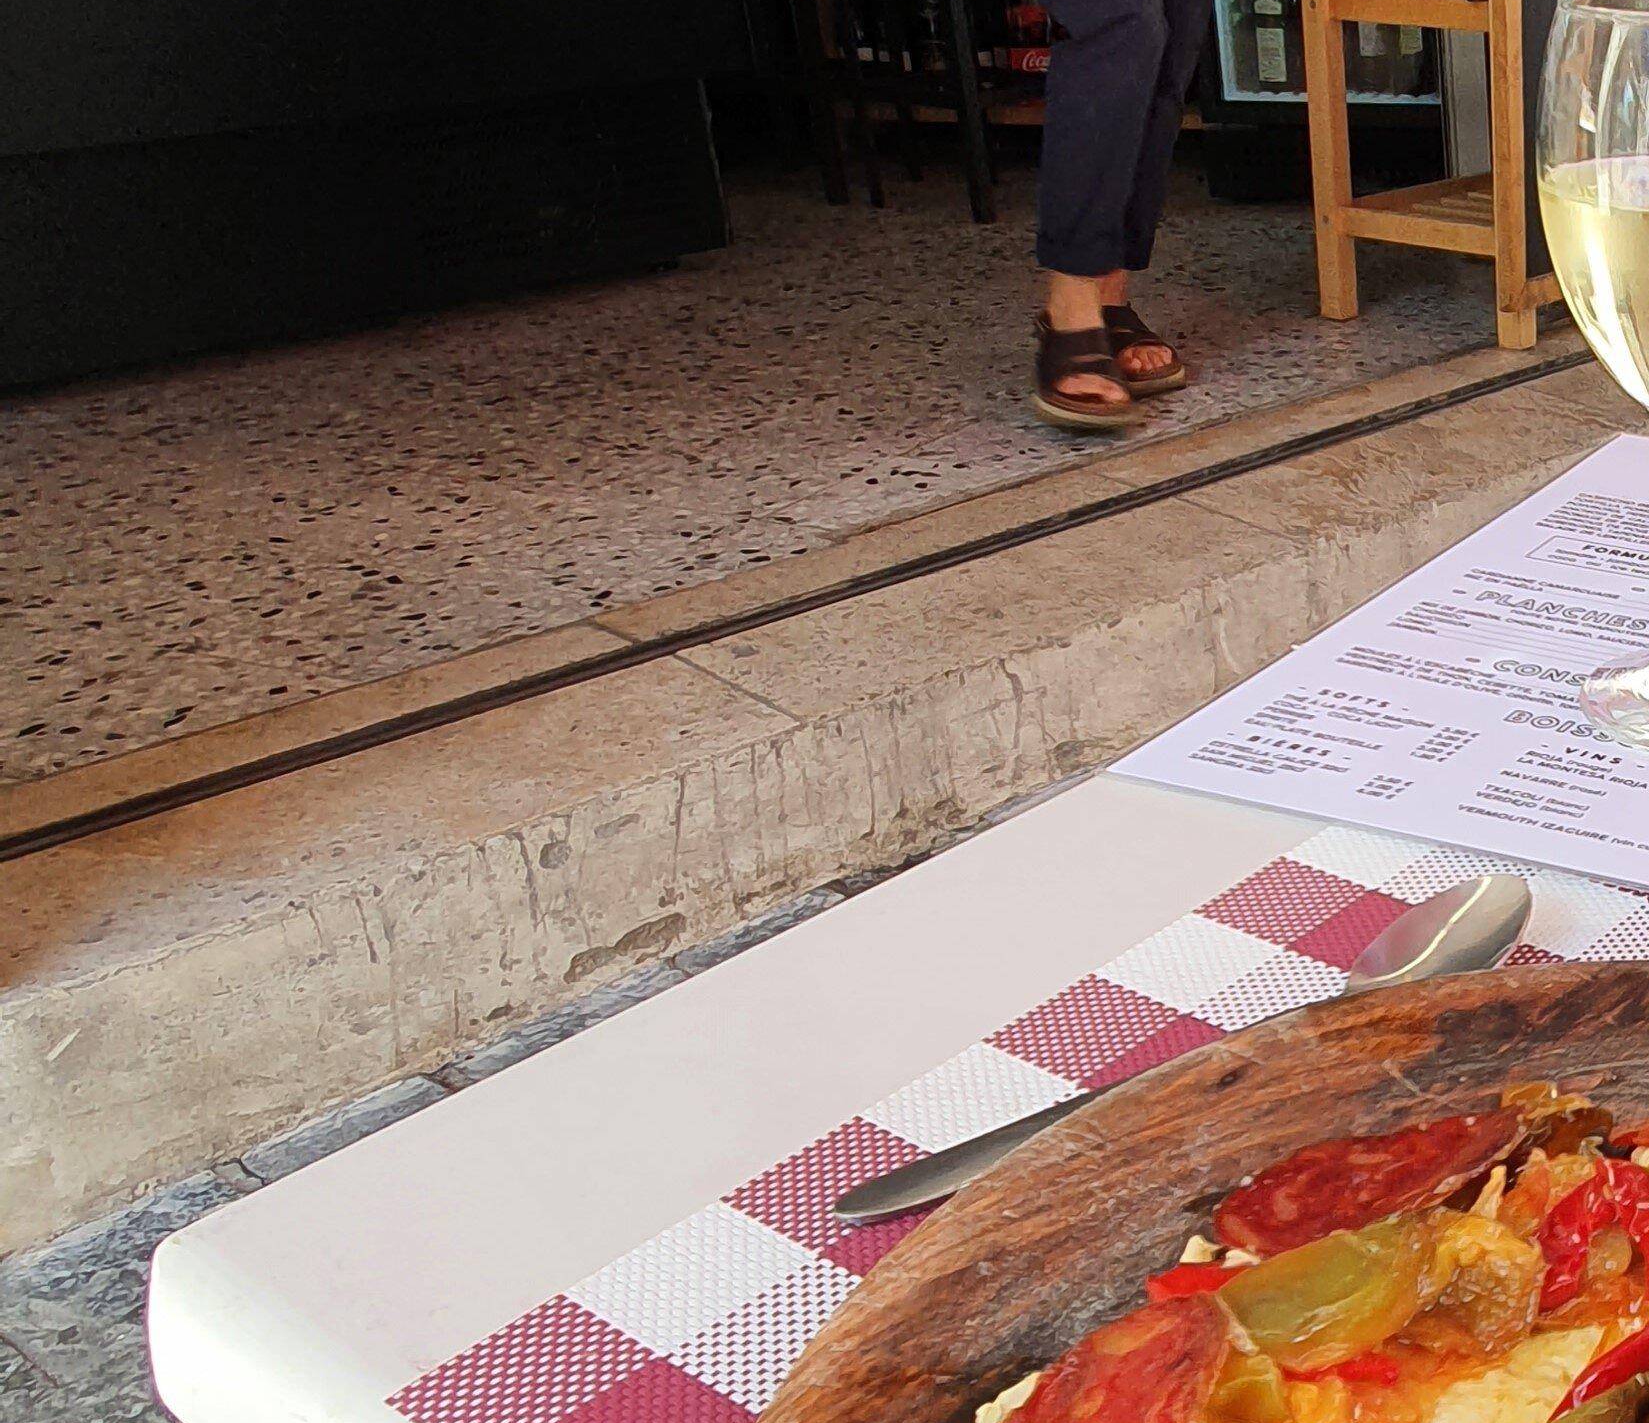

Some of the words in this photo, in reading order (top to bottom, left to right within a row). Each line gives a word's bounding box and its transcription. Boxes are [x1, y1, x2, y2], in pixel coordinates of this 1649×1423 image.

[1475, 590, 1649, 631] PLANCHES
[1318, 688, 1391, 708] SOFTS
[1525, 750, 1564, 764] RIOJA
[1565, 759, 1615, 773] (rouge)
[1565, 746, 1624, 765] VINS
[1500, 770, 1567, 789] NAVARRE
[1536, 761, 1605, 780] MONTESA
[1609, 776, 1648, 790] RIOJA
[1476, 790, 1537, 809] VERDEJO
[1485, 783, 1544, 802] TXACOLI
[1458, 804, 1538, 826] VERMOUTH
